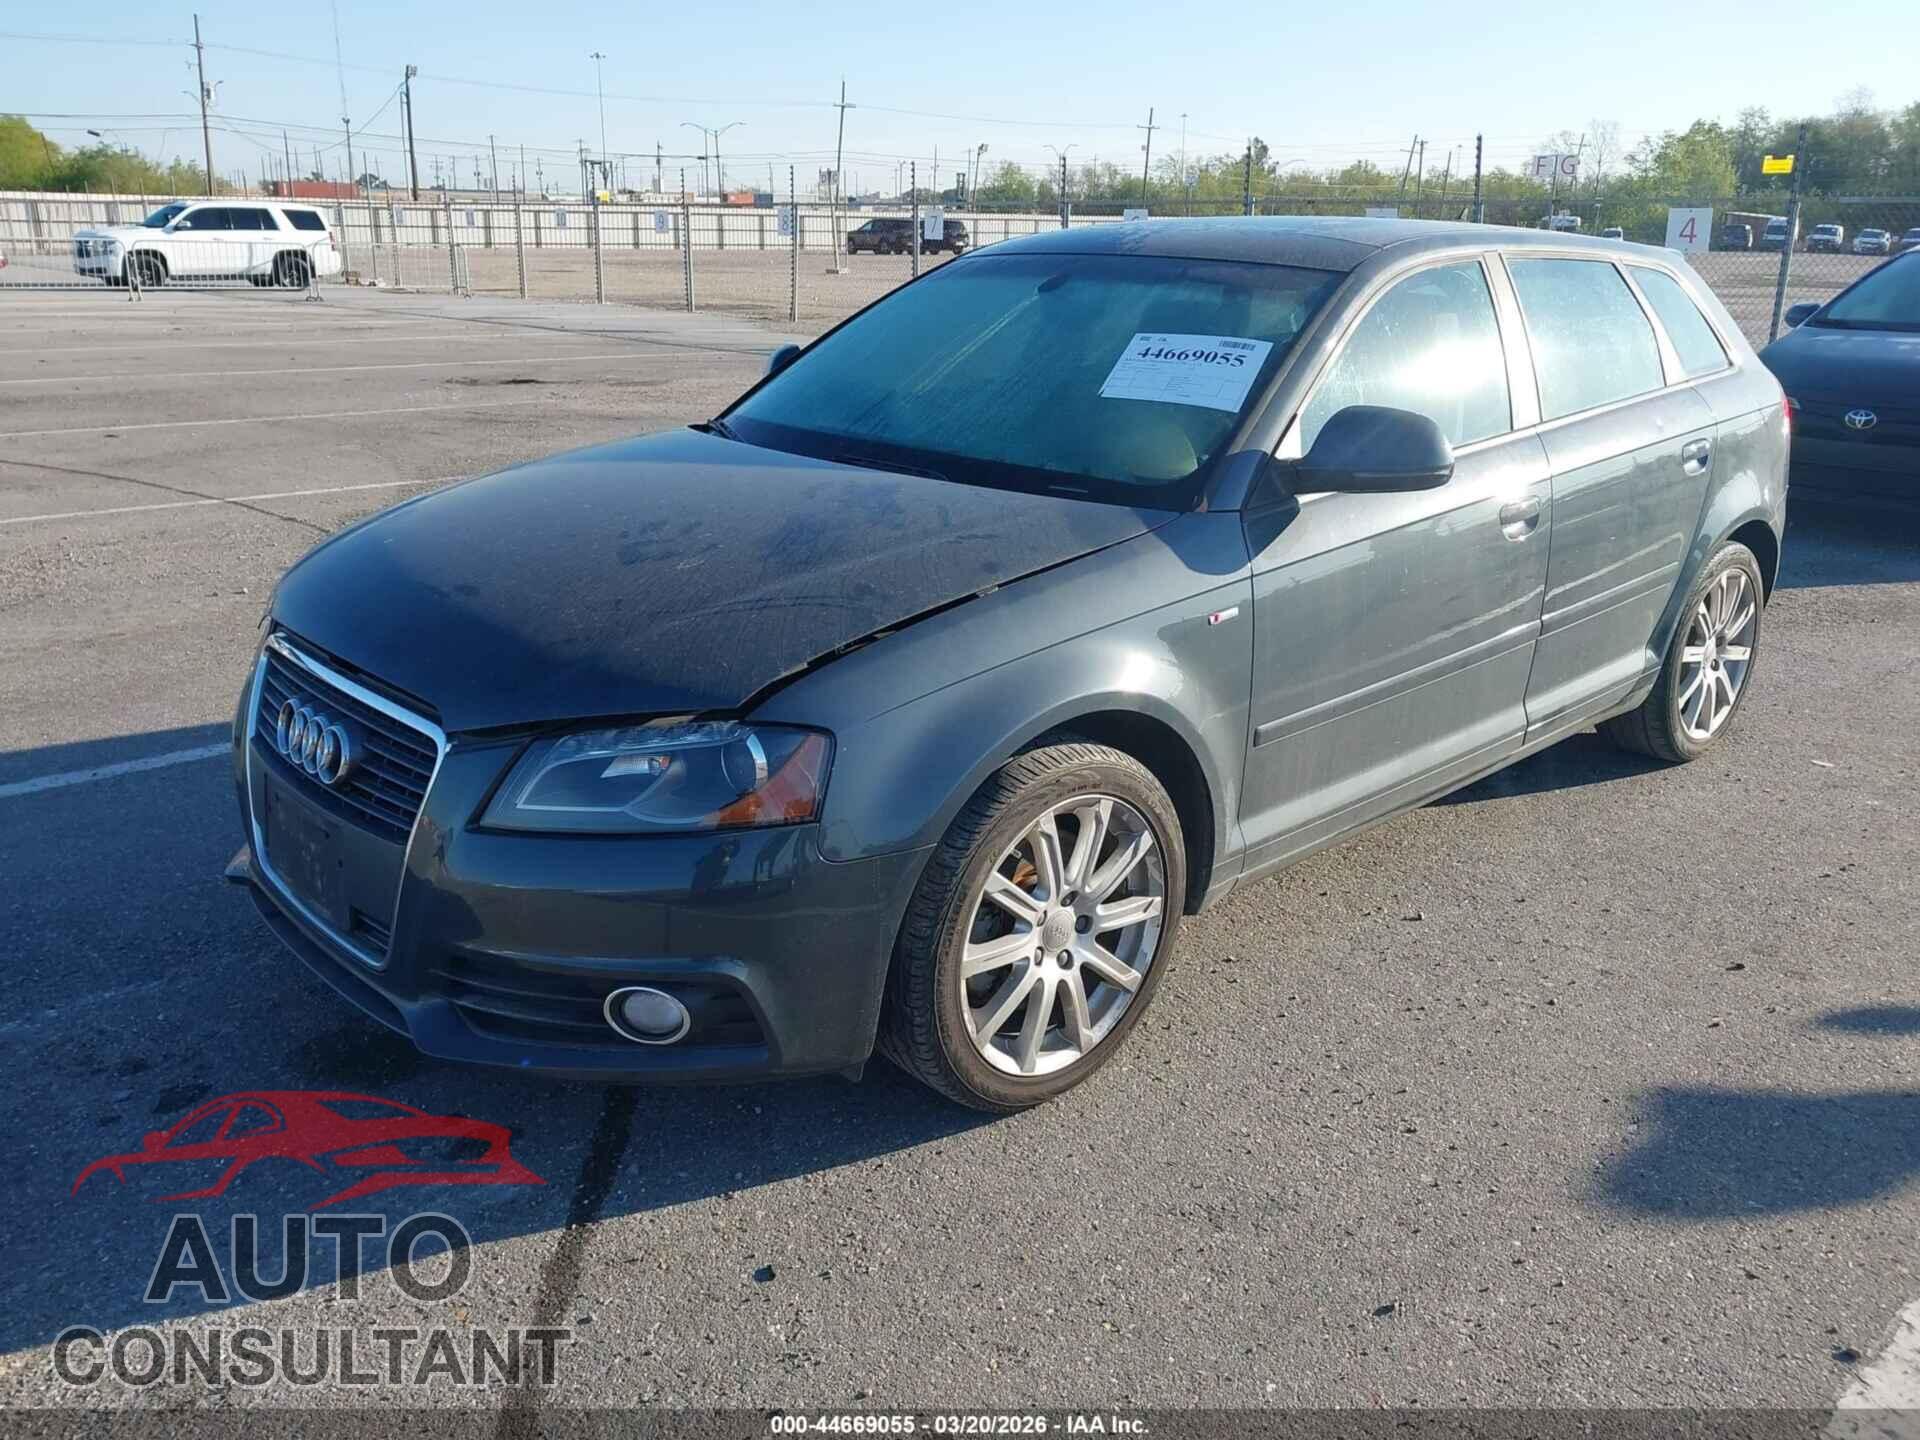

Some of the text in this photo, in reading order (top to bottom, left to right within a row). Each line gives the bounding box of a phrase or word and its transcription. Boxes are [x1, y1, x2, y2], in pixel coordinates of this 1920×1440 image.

[1536, 155, 1576, 176] F G
[782, 214, 789, 231] 8
[930, 215, 938, 233] 7
[1679, 217, 1697, 244] 4
[1137, 346, 1248, 368] 44669055
